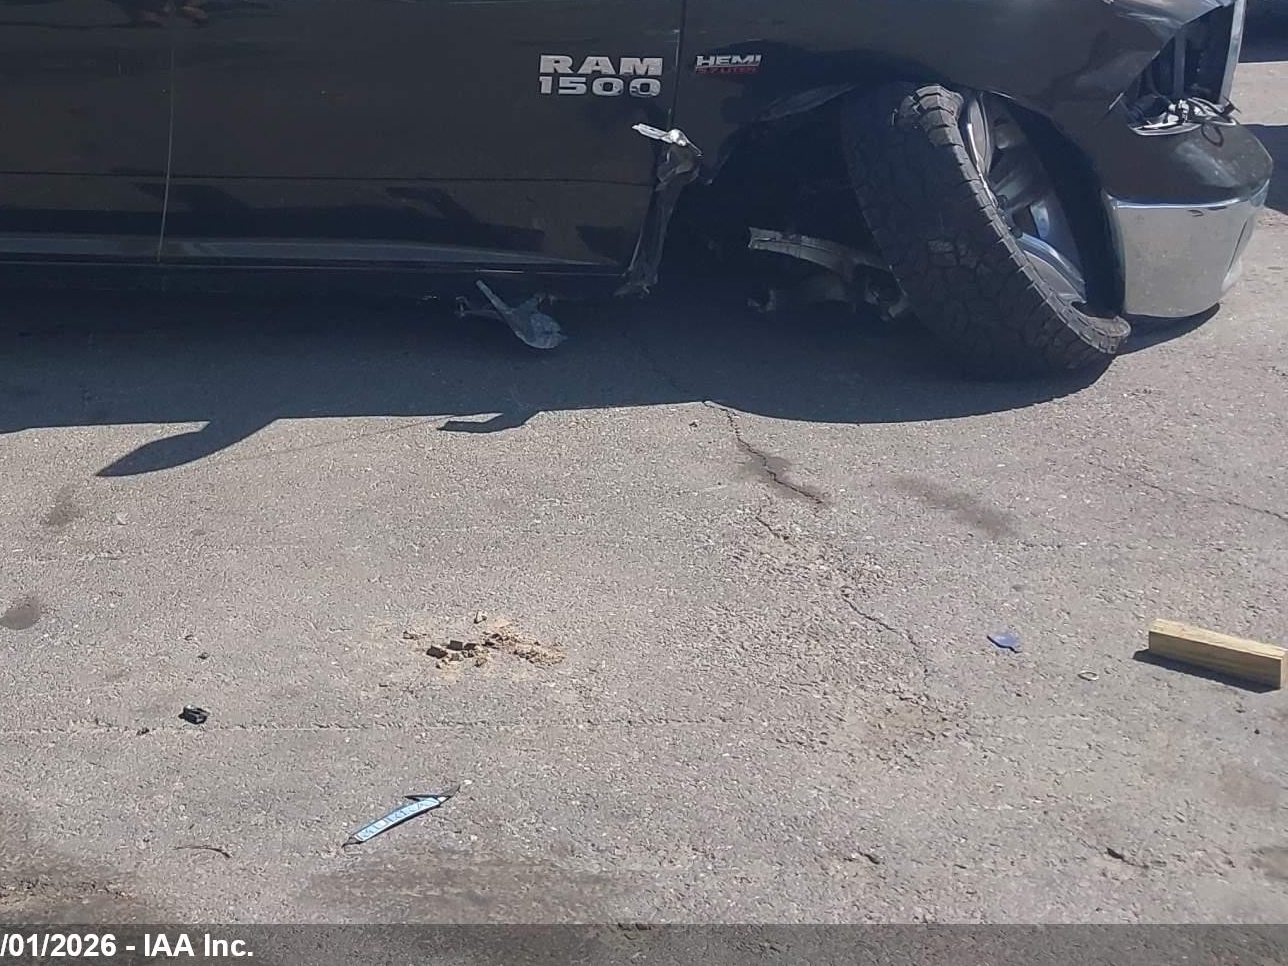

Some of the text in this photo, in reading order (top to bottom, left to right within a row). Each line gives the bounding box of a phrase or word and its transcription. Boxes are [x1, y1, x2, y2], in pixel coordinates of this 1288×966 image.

[539, 54, 663, 76] RAM
[696, 54, 762, 67] HEMI
[539, 76, 662, 97] 1500
